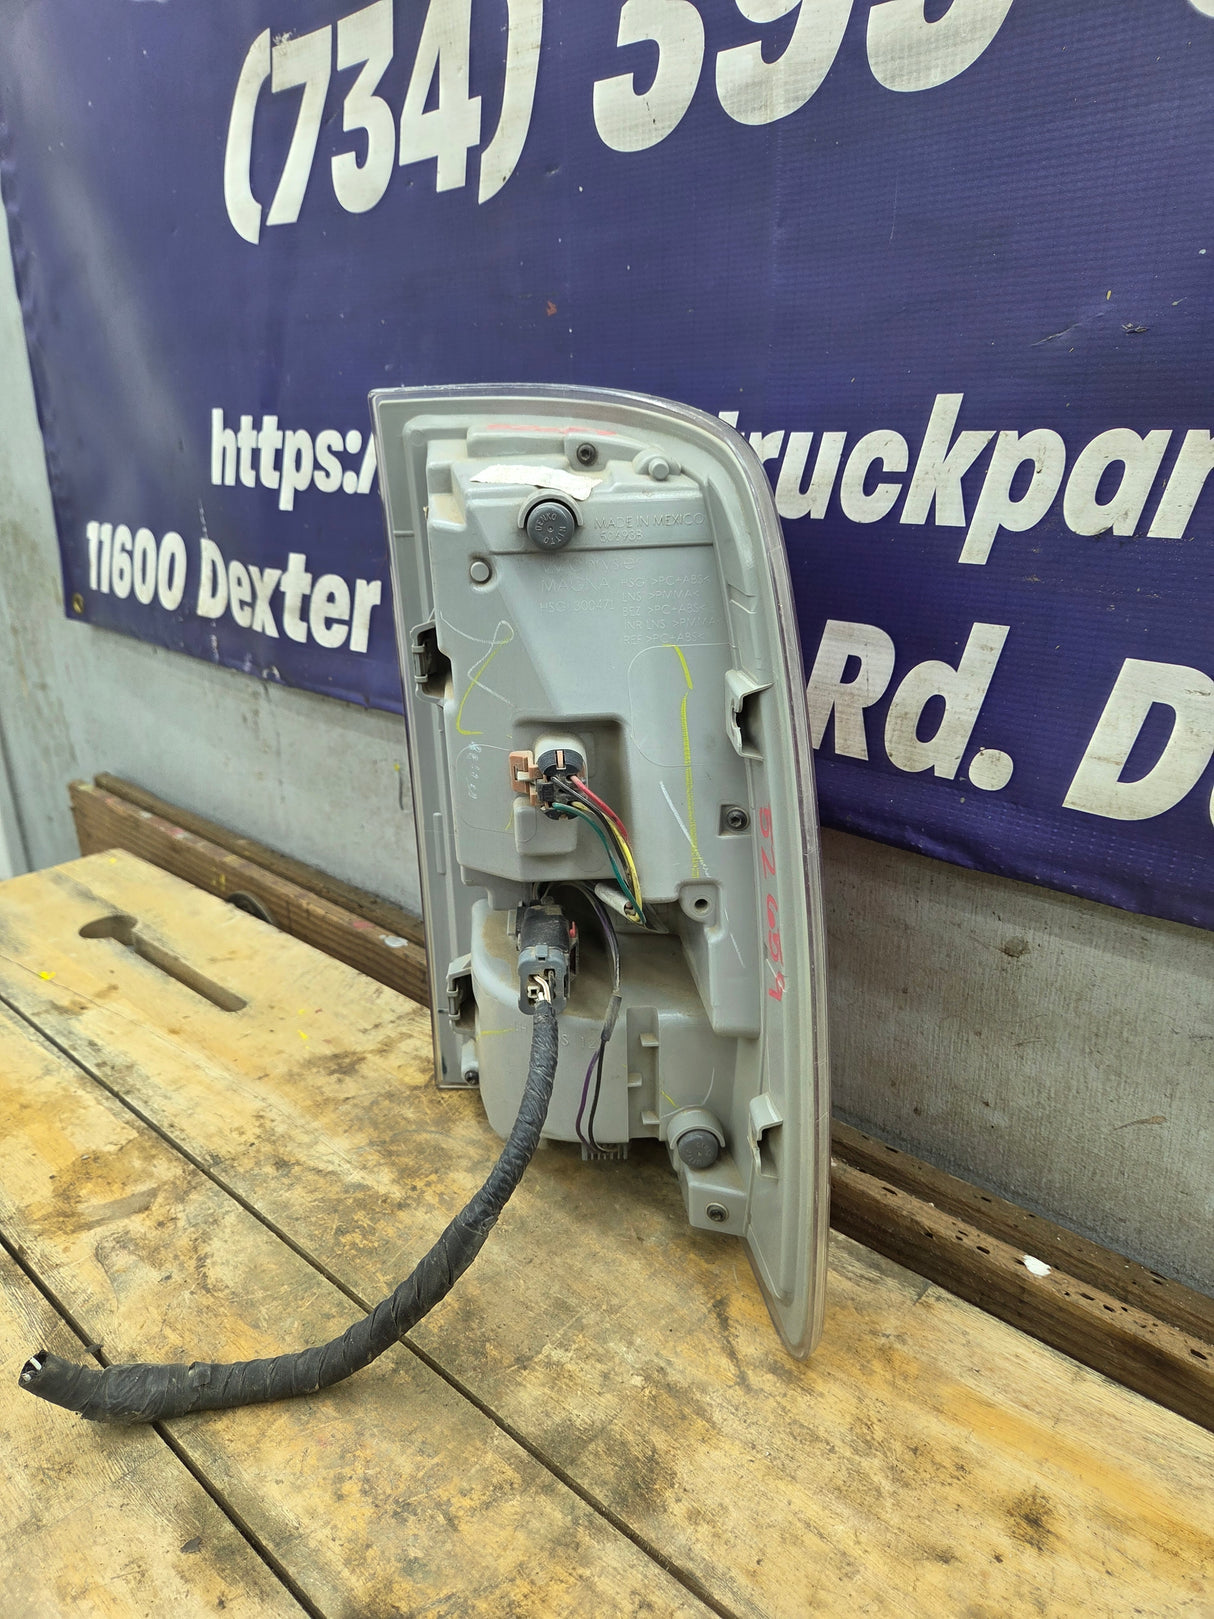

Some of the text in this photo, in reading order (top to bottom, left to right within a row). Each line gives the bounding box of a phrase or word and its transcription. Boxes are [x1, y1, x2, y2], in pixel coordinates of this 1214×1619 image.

[224, 0, 543, 245] (734)
[594, 512, 705, 530] MADE IN MEXICO
[86, 520, 1214, 828] 11600 Dexter Rd. D
